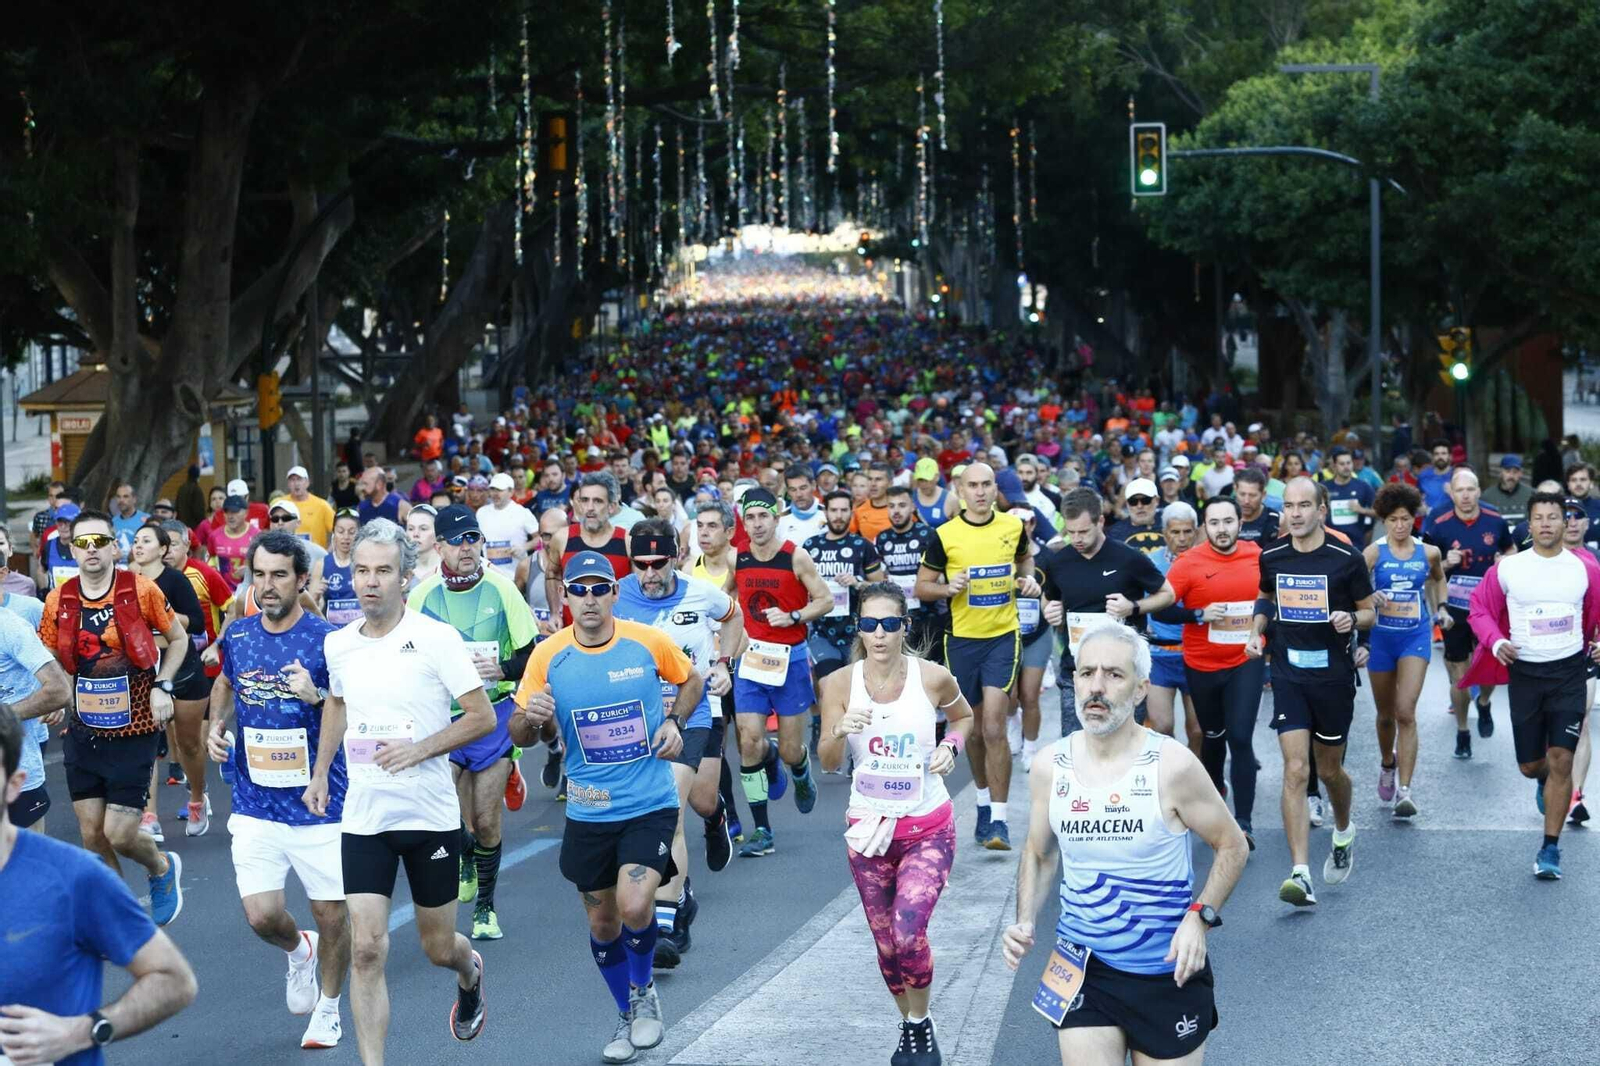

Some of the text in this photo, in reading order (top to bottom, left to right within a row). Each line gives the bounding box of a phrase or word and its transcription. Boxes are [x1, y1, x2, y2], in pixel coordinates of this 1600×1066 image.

[893, 543, 908, 554] XIX
[820, 550, 838, 562] XIX
[1299, 593, 1319, 601] 2042
[93, 682, 117, 690] ZURICH
[98, 697, 120, 706] 2187
[600, 706, 629, 719] ZURICH
[369, 724, 399, 732] ZURICH
[607, 724, 636, 739] 2834
[270, 751, 297, 762] 6324
[881, 762, 910, 770] ZURICH
[883, 780, 912, 791] 6450
[1060, 818, 1145, 835] MARACENA
[1049, 960, 1075, 984] 2054
